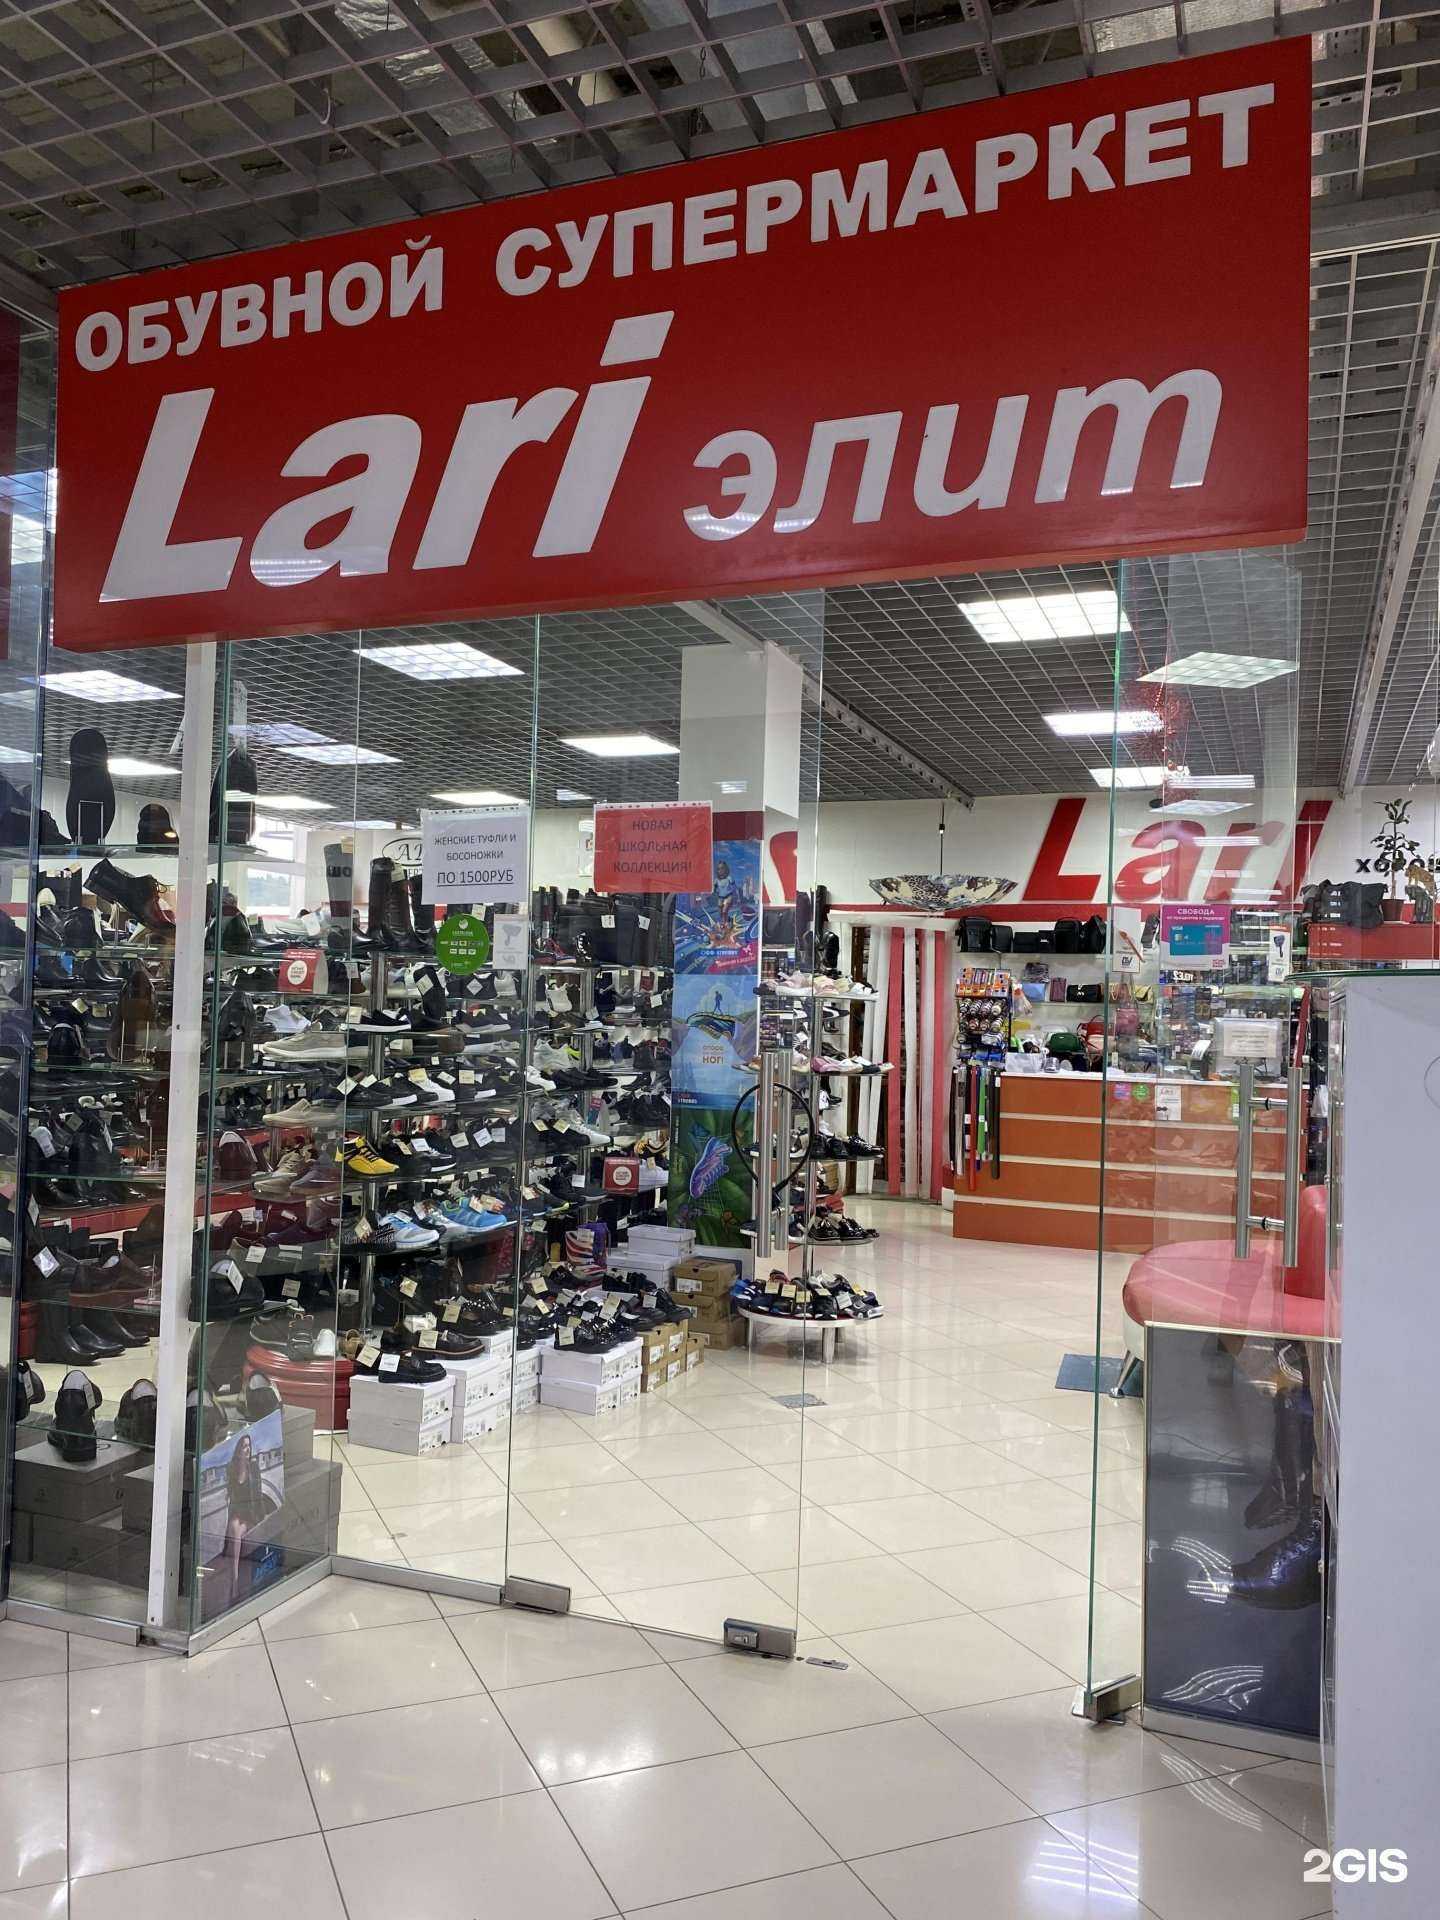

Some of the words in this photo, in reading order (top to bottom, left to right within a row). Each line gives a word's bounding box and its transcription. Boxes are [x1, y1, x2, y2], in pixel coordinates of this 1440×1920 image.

[74, 235, 445, 373] ОБУВНОЙ
[495, 82, 1276, 298] СУПЕРМАРКЕТ
[98, 310, 675, 604] Lari
[682, 367, 1224, 542] элит
[632, 819, 673, 831] НОВАЯ
[434, 835, 475, 846] ЖЕНСКИЕ
[477, 834, 507, 844] ТУФЛИ
[509, 834, 517, 842] И
[618, 840, 688, 852] ШКОЛЬНАЯ
[446, 850, 504, 861] БОСОНОЖКИ
[613, 861, 692, 874] КОЛЛЕКЦИЯ!
[437, 872, 456, 883] ПО
[460, 869, 514, 884] 1500РУБ
[1177, 908, 1215, 916] СВОБОДА
